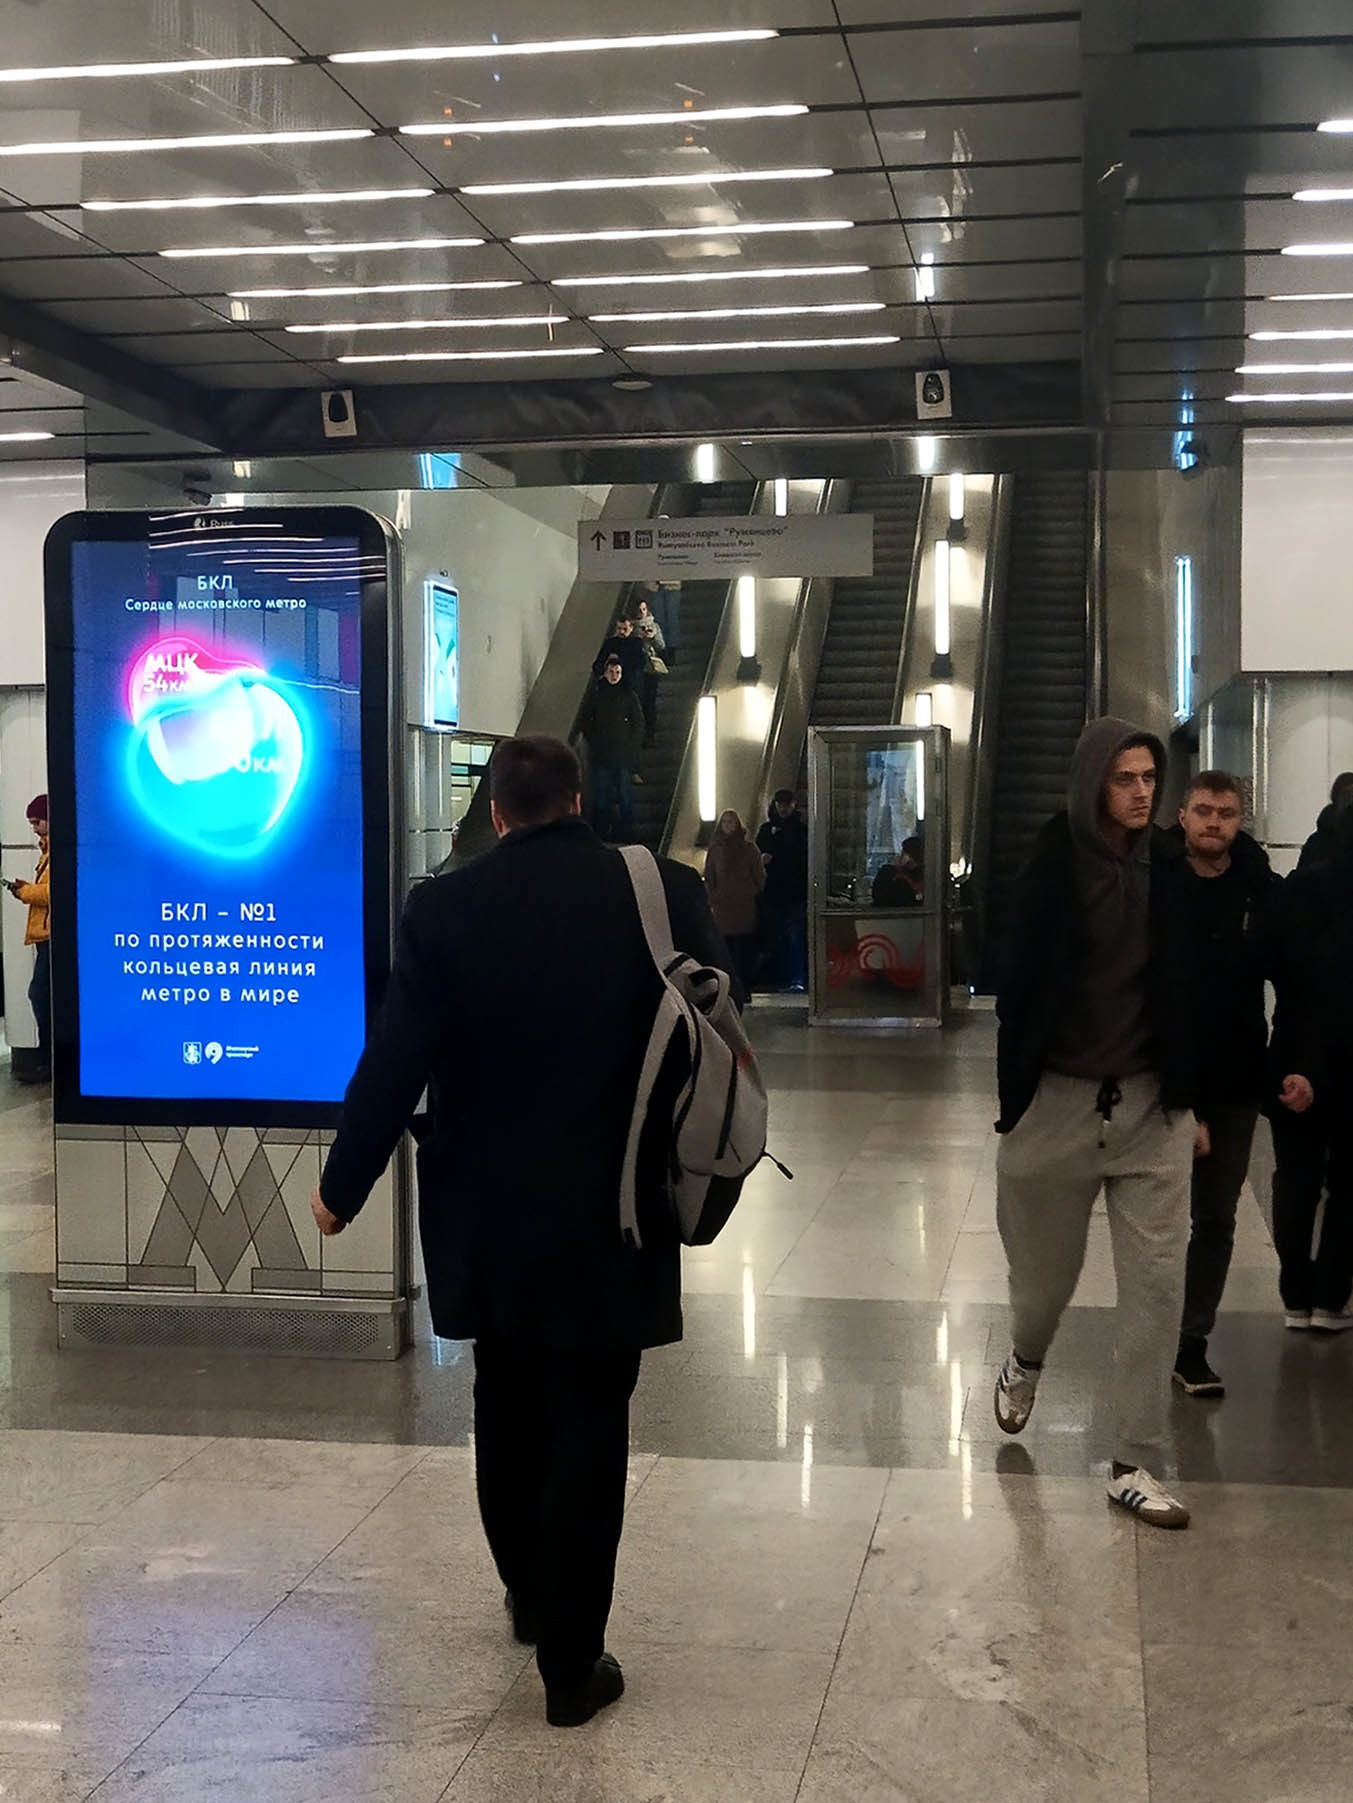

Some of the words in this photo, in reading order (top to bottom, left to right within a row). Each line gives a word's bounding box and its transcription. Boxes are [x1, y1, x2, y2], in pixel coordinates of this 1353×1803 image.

[198, 575, 233, 590] БКЛ
[125, 598, 174, 611] Сердце
[177, 600, 262, 610] московского
[265, 599, 308, 611] метро
[146, 653, 199, 674] МЦК
[161, 902, 206, 921] БКЛ
[240, 902, 276, 921] №1
[114, 934, 139, 948] по
[150, 934, 324, 951] протяженности
[123, 961, 239, 977] кольцевая
[249, 961, 315, 976] линия
[141, 988, 210, 1005] метро
[220, 988, 231, 1002] в
[240, 989, 300, 1006] мире
